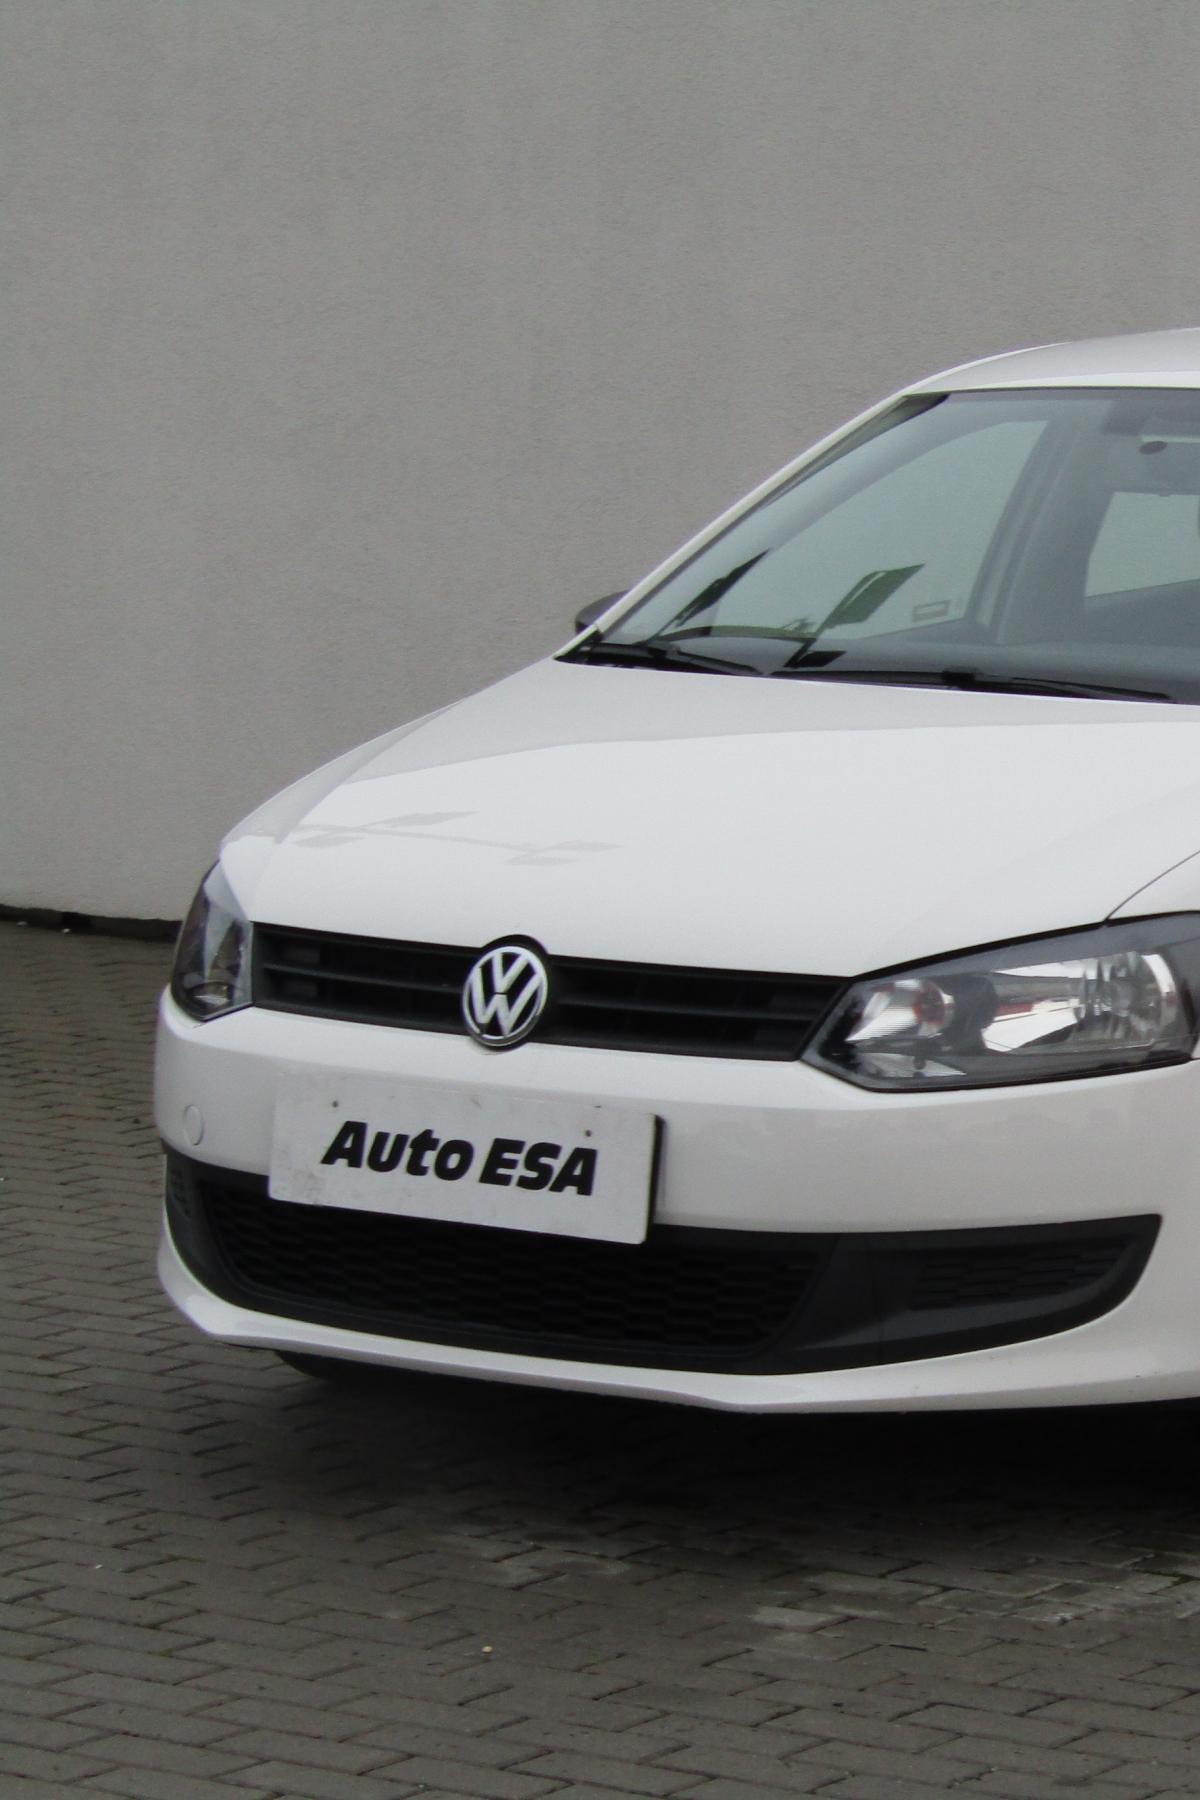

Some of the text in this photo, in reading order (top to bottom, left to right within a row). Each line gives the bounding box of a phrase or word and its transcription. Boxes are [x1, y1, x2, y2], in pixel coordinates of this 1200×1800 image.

[464, 947, 547, 1040] VW
[320, 1120, 598, 1197] Auto ESA
